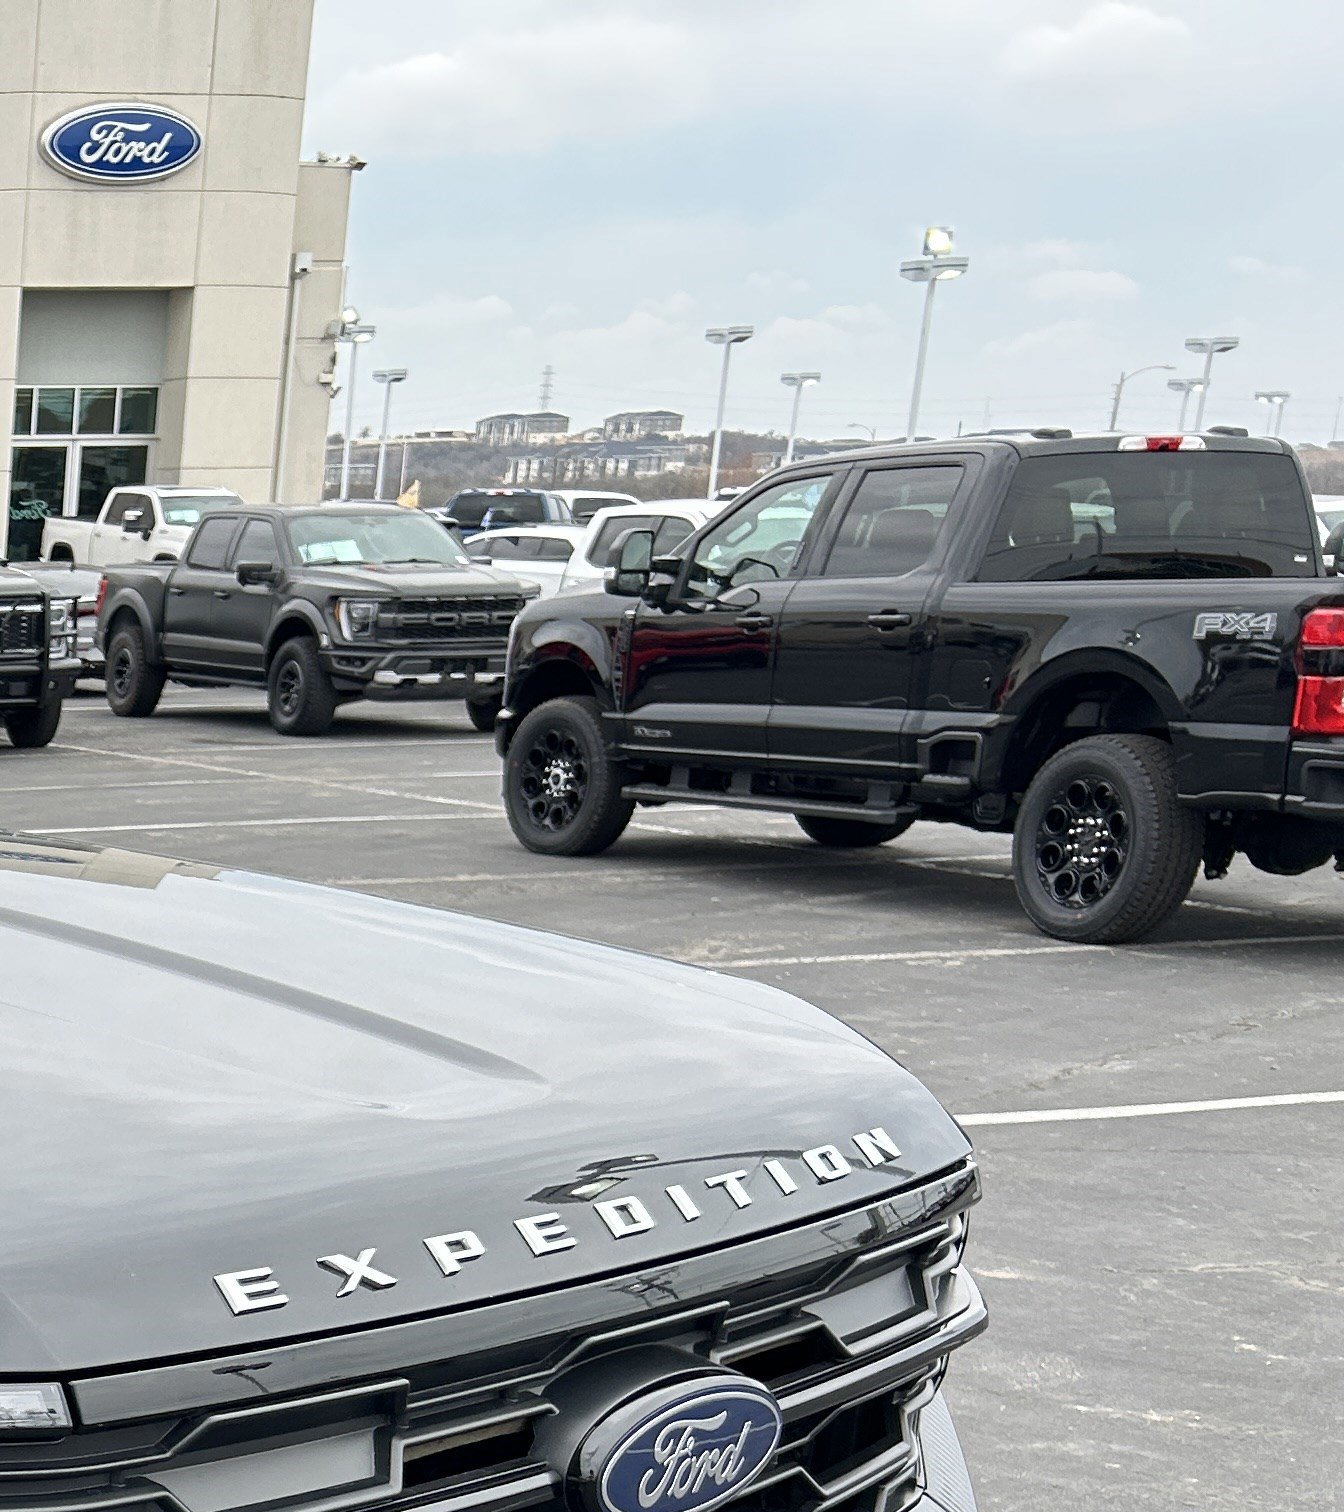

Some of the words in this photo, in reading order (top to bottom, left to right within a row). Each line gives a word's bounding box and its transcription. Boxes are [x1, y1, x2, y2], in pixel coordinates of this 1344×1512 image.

[78, 121, 172, 164] Ford
[1193, 612, 1278, 640] FX4
[213, 1127, 904, 1317] EXPEDITION
